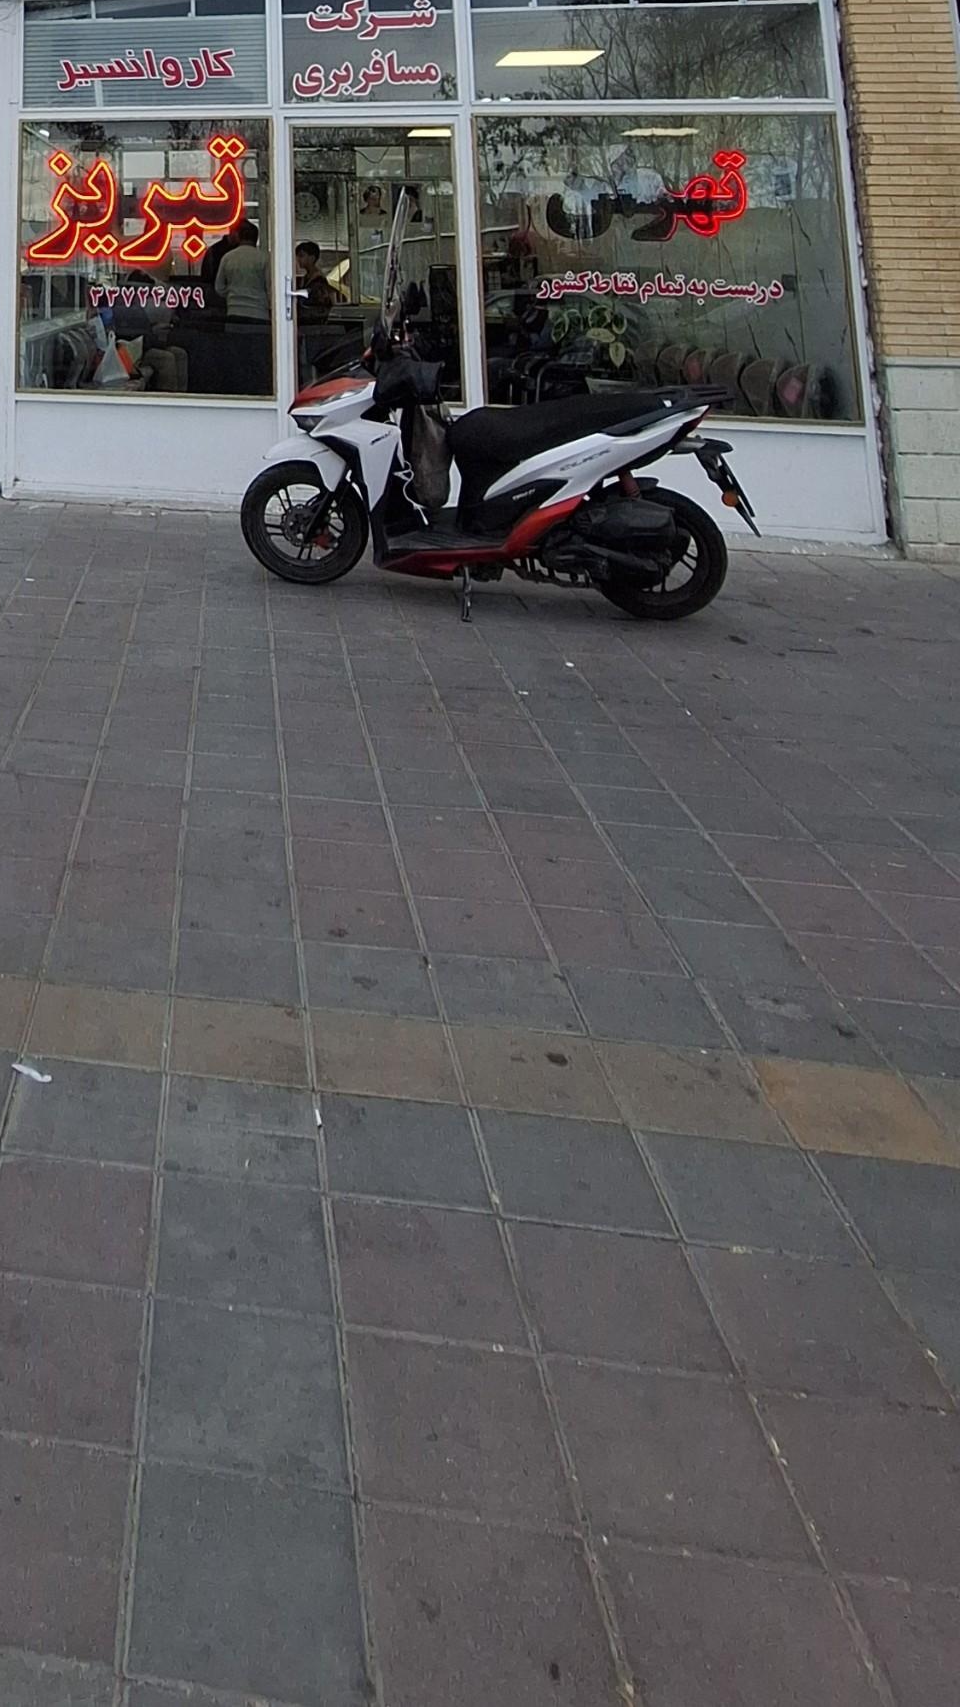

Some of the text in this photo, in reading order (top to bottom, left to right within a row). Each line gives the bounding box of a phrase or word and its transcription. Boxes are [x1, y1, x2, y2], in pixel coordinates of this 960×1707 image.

[293, 48, 441, 97] مسافربری
[28, 136, 245, 264] تبریز
[89, 285, 205, 308] ۳۳۷۲۴۵۲۹
[537, 270, 783, 306] دربست به تمام نقاط کشور
